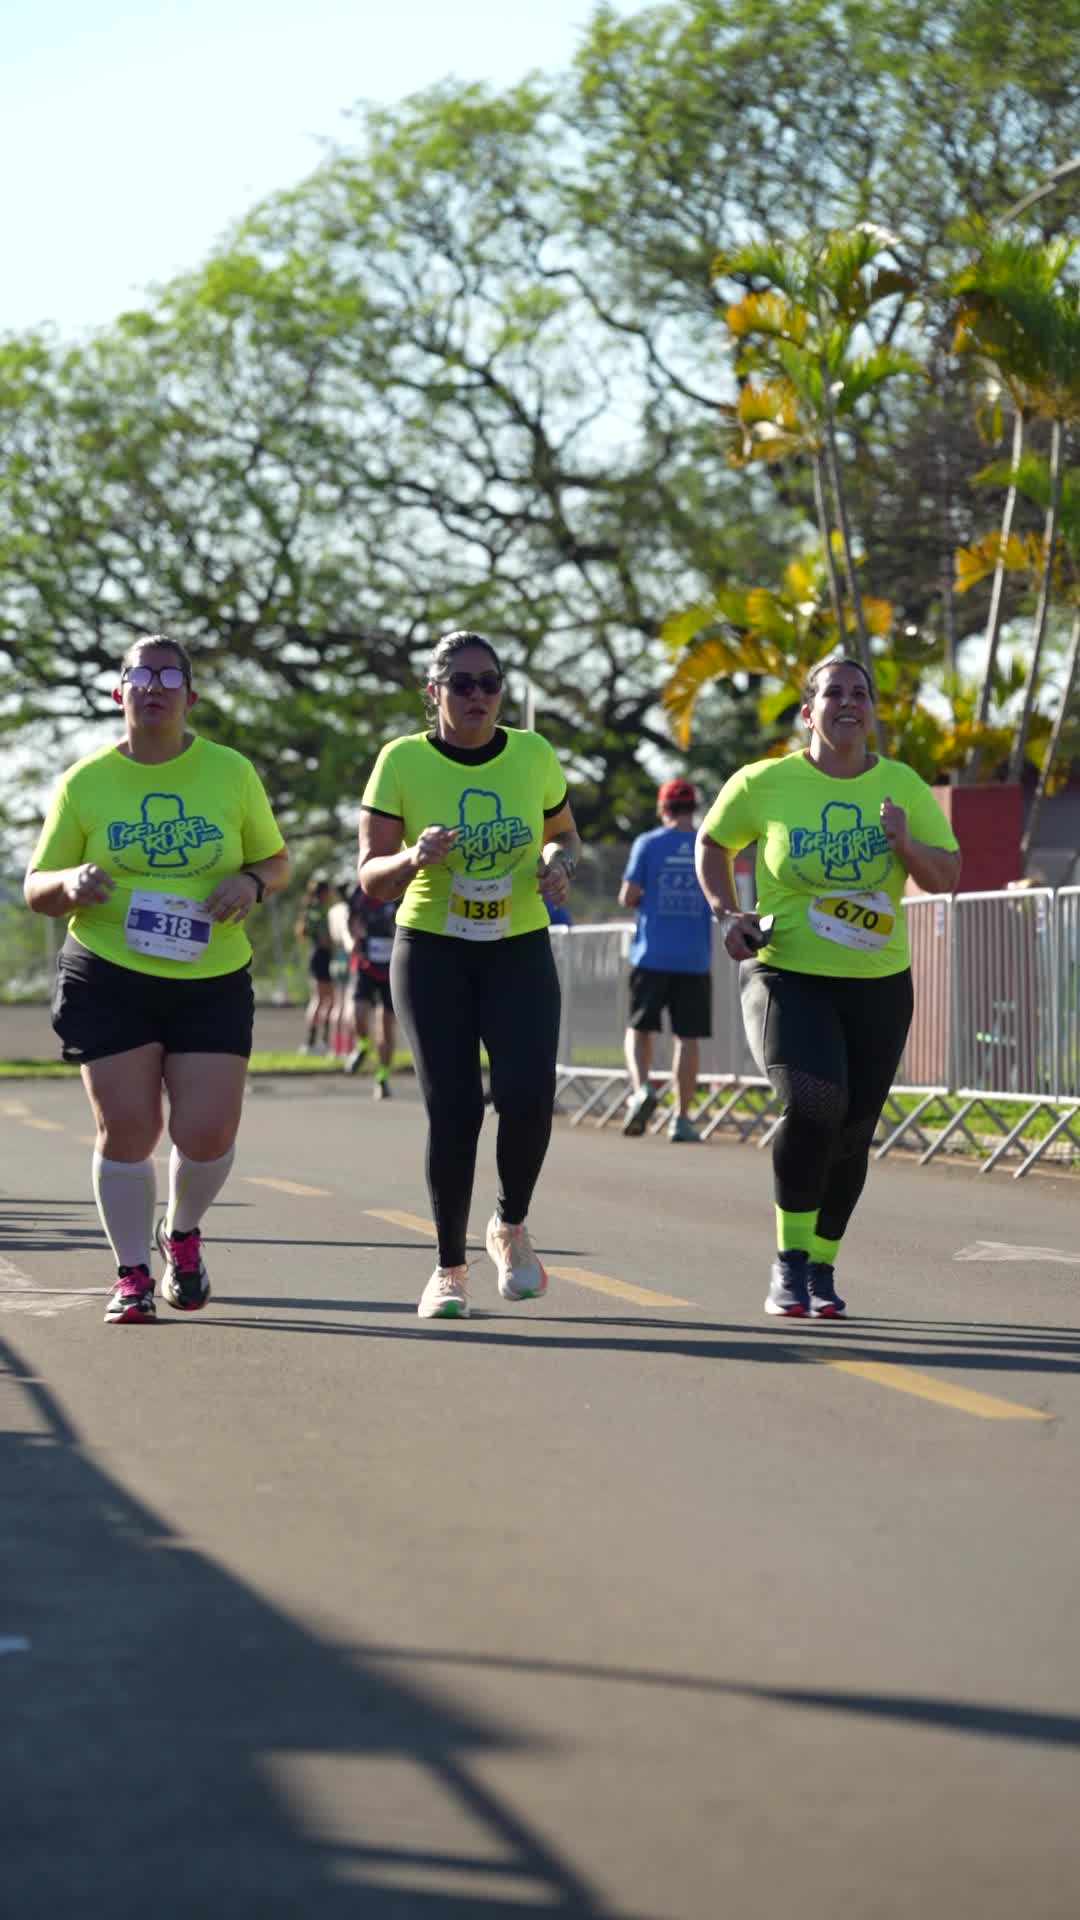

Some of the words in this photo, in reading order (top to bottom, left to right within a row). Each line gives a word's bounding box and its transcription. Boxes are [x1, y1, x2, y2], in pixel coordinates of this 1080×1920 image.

[144, 830, 200, 854] RUN
[463, 833, 512, 859] RUN
[822, 838, 873, 867] RUN
[463, 899, 505, 919] 1381
[834, 900, 879, 930] 670
[151, 913, 193, 938] 318
